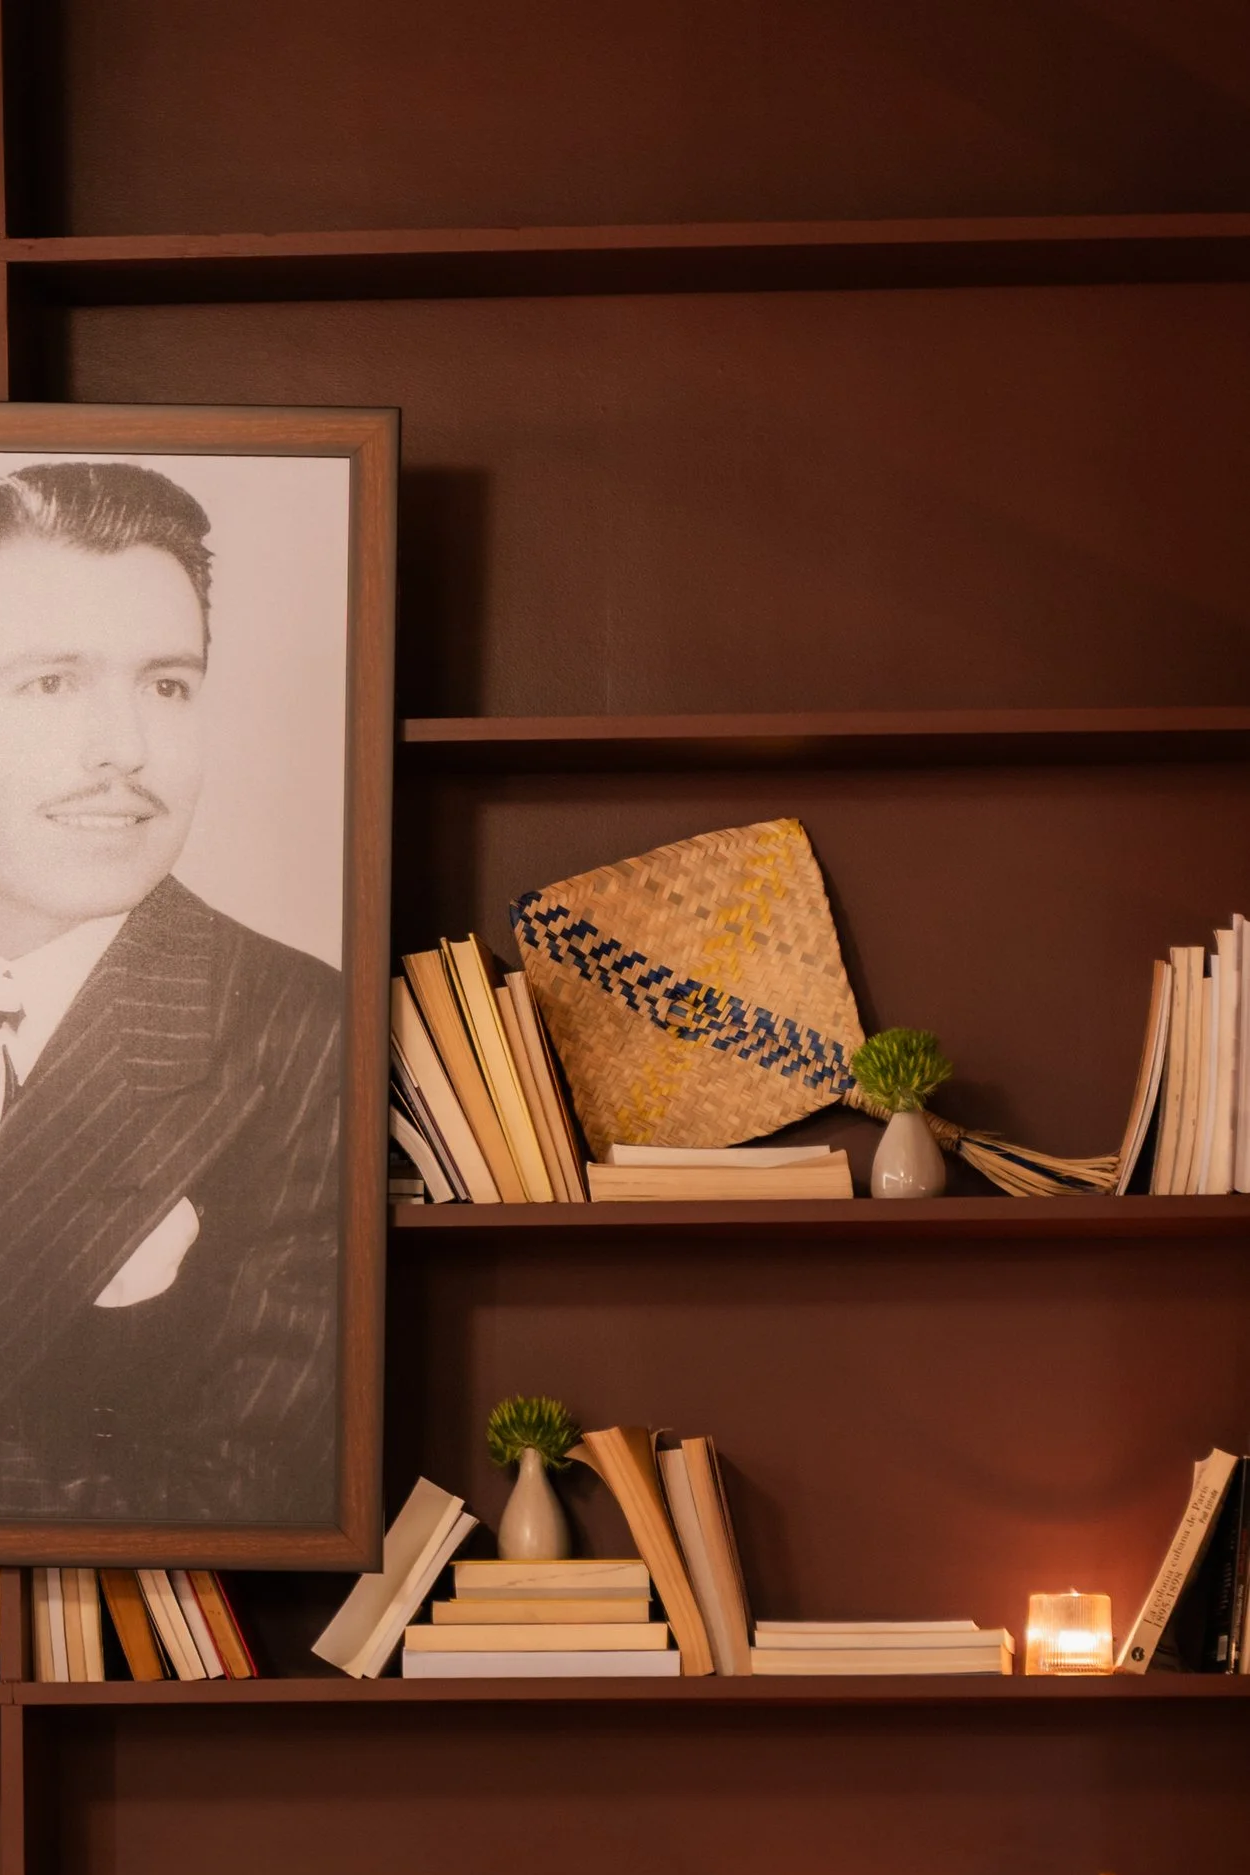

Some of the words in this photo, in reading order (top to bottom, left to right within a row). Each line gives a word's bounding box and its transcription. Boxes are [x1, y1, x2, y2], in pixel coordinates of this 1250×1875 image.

[1152, 1569, 1174, 1608] colonia
[1170, 1529, 1191, 1567] cubana
[1154, 1572, 1184, 1628] 1895-1898
